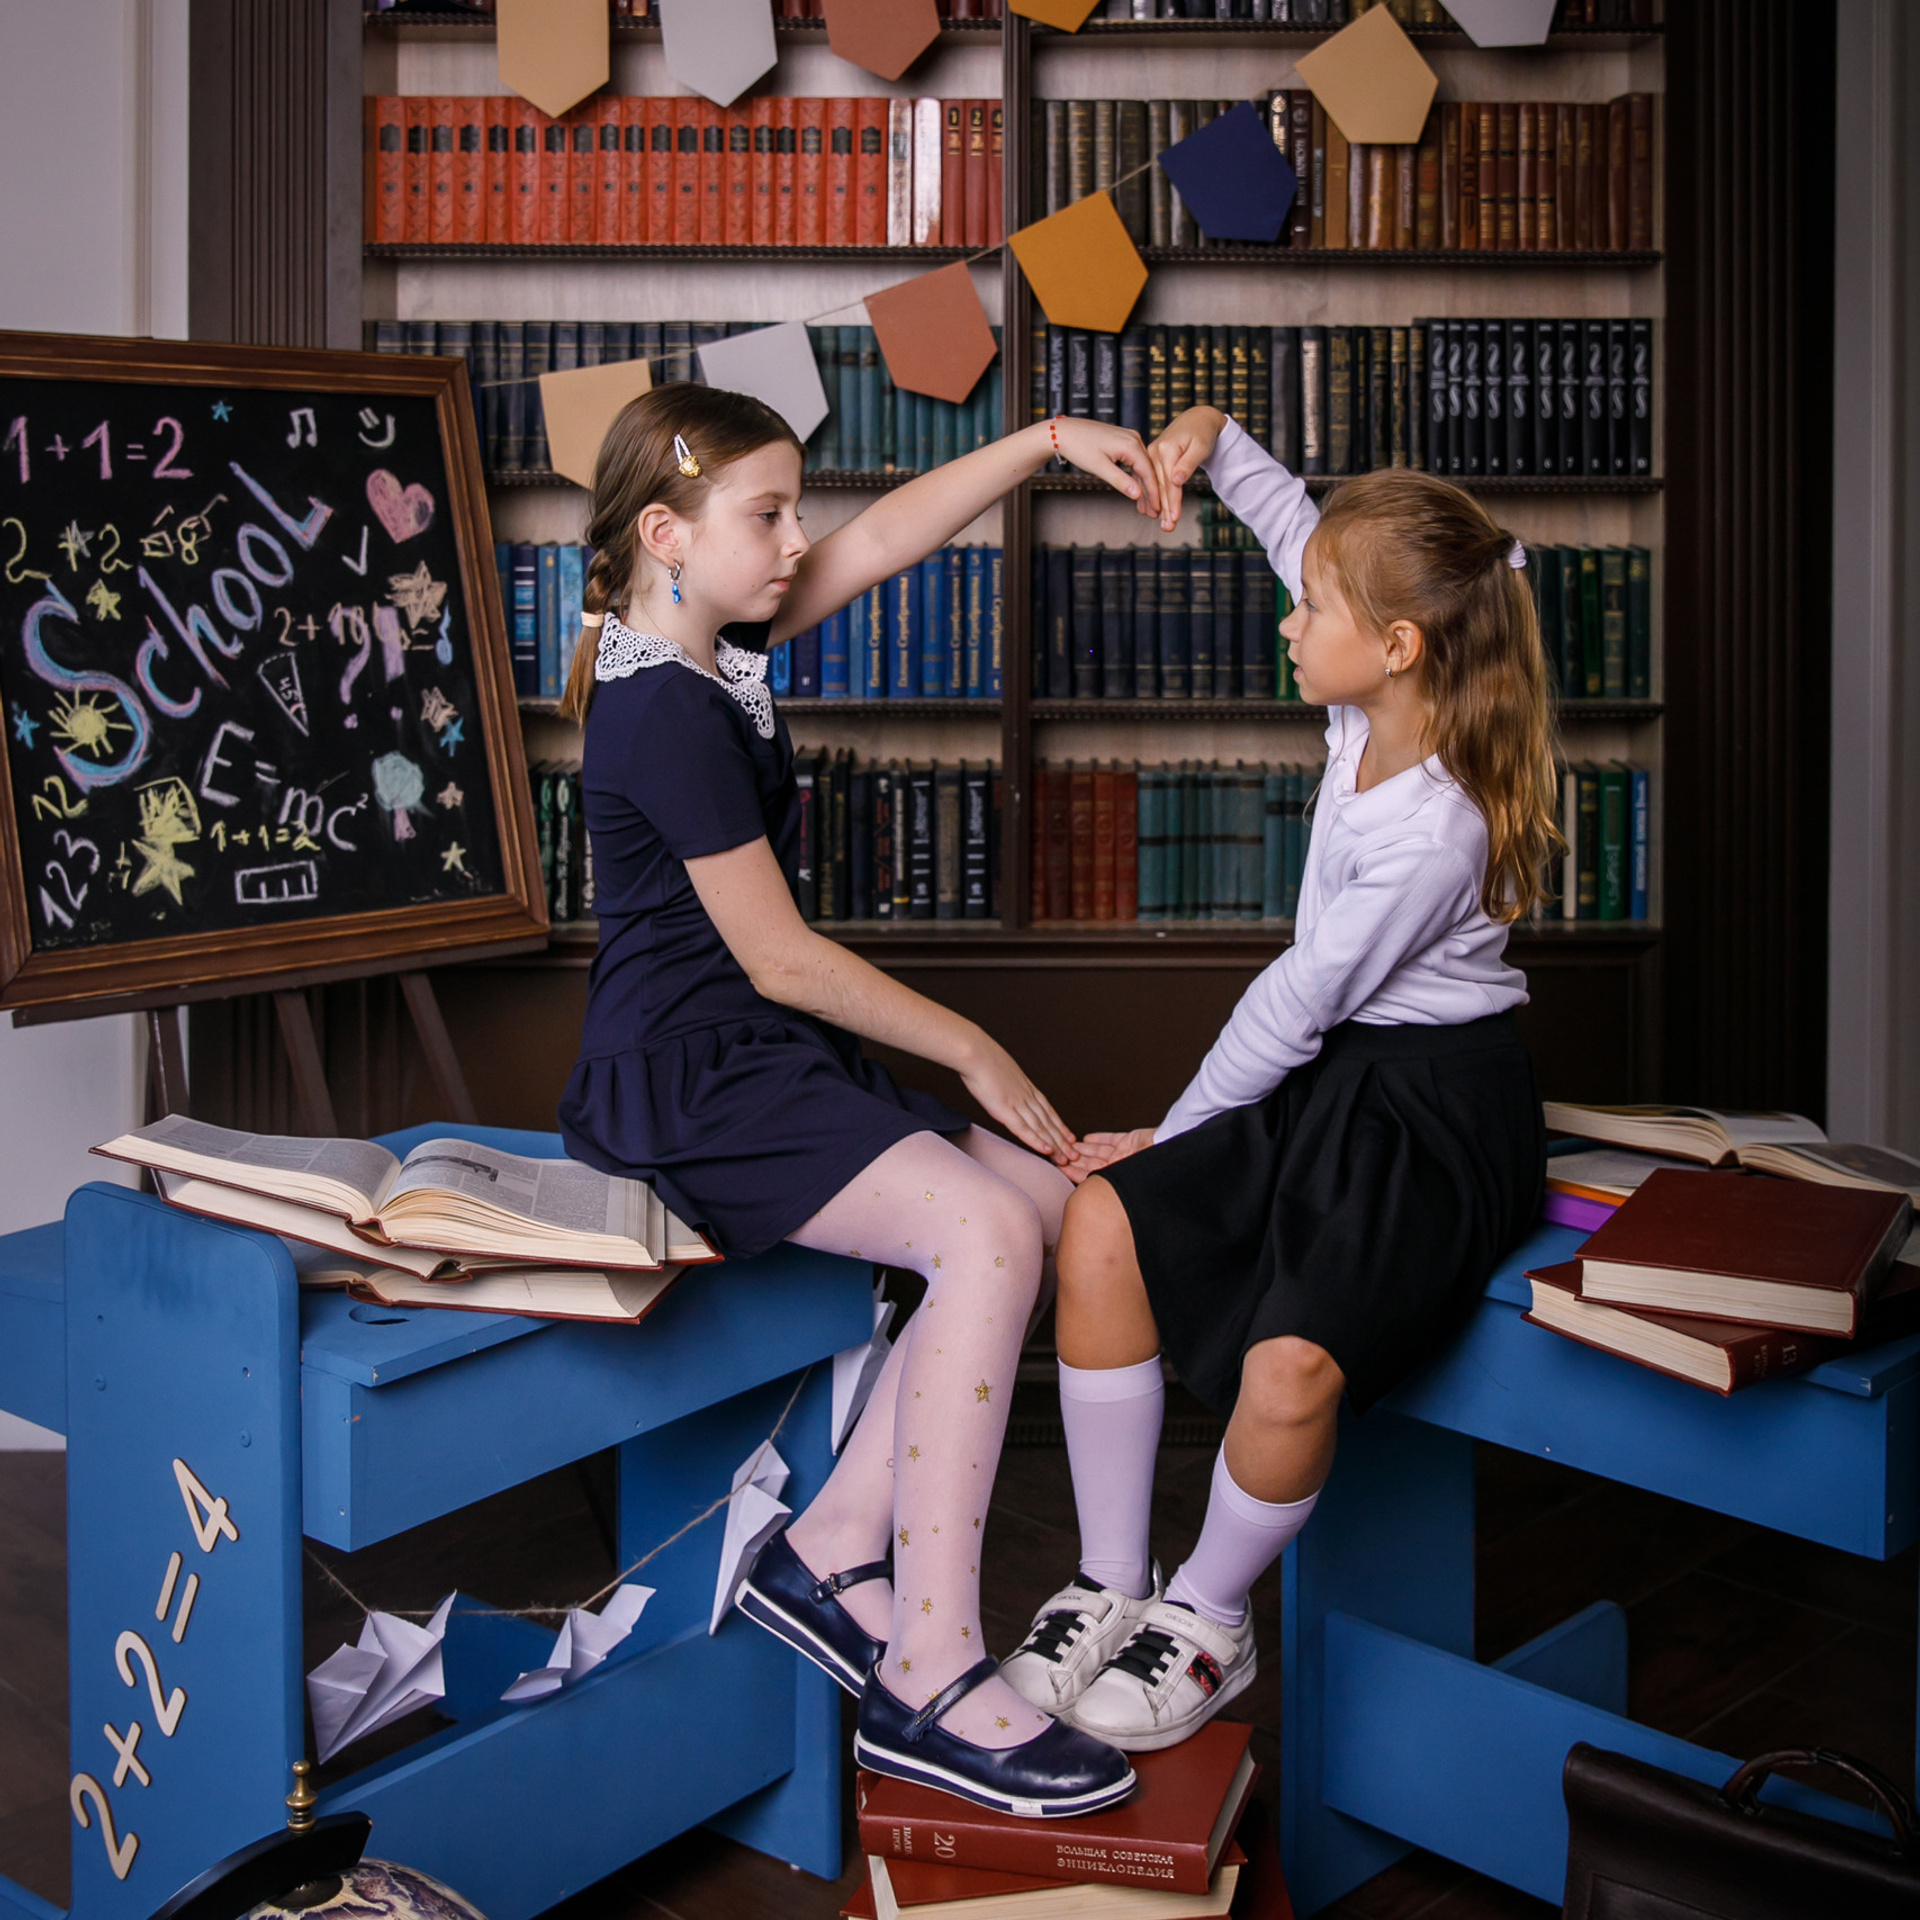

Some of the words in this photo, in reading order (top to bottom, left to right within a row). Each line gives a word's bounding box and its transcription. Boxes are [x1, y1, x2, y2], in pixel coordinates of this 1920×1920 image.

[1050, 336, 1063, 392] РЕМАРК
[1164, 1612, 1194, 1629] GEOX
[934, 1831, 956, 1859] 20
[1056, 1845, 1107, 1859] БОЛЬШАЯ
[1112, 1850, 1174, 1865] СОВЕТСКАЯ
[1057, 1858, 1175, 1879] ЭНЦИКЛОПЕДИЯ
